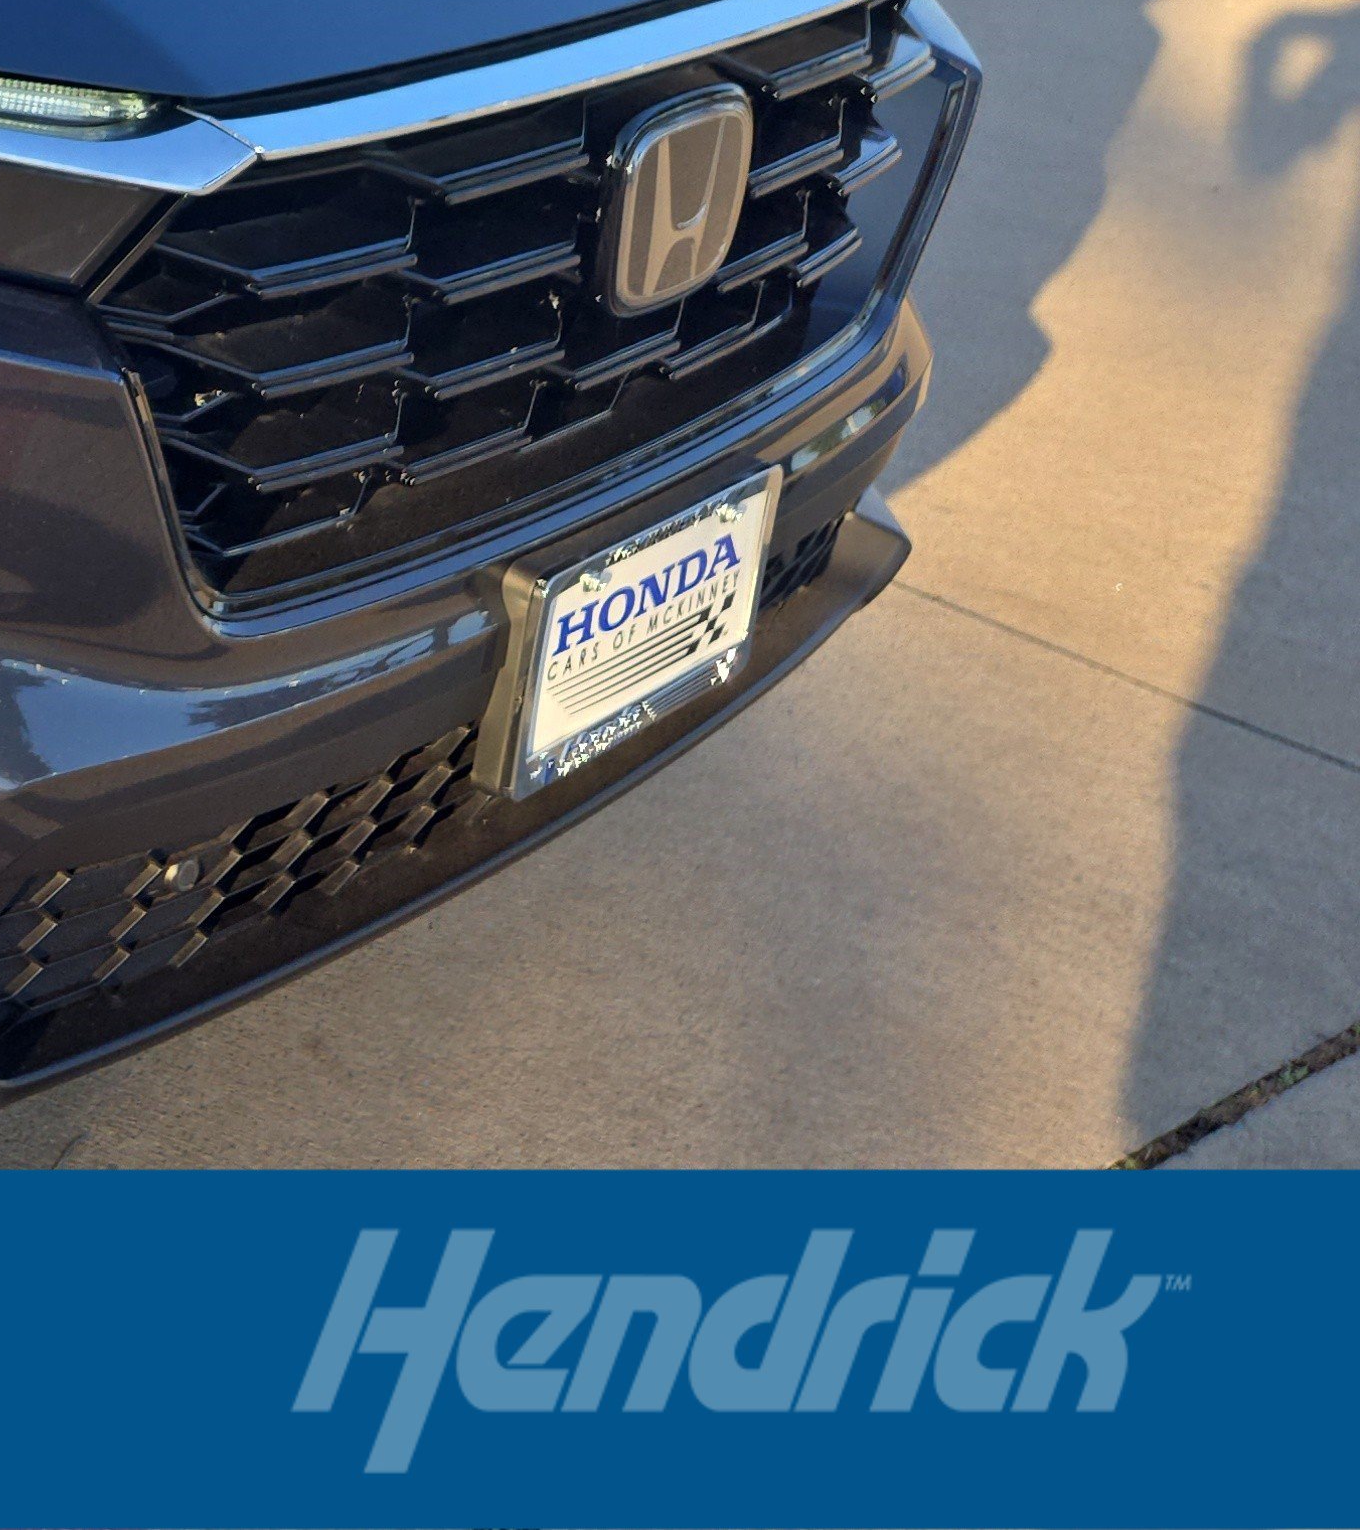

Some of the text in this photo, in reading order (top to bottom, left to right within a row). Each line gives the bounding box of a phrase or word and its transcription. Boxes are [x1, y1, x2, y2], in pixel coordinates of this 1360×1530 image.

[547, 568, 741, 681] CARS OF MCKINNEY
[552, 533, 741, 657] HONDA
